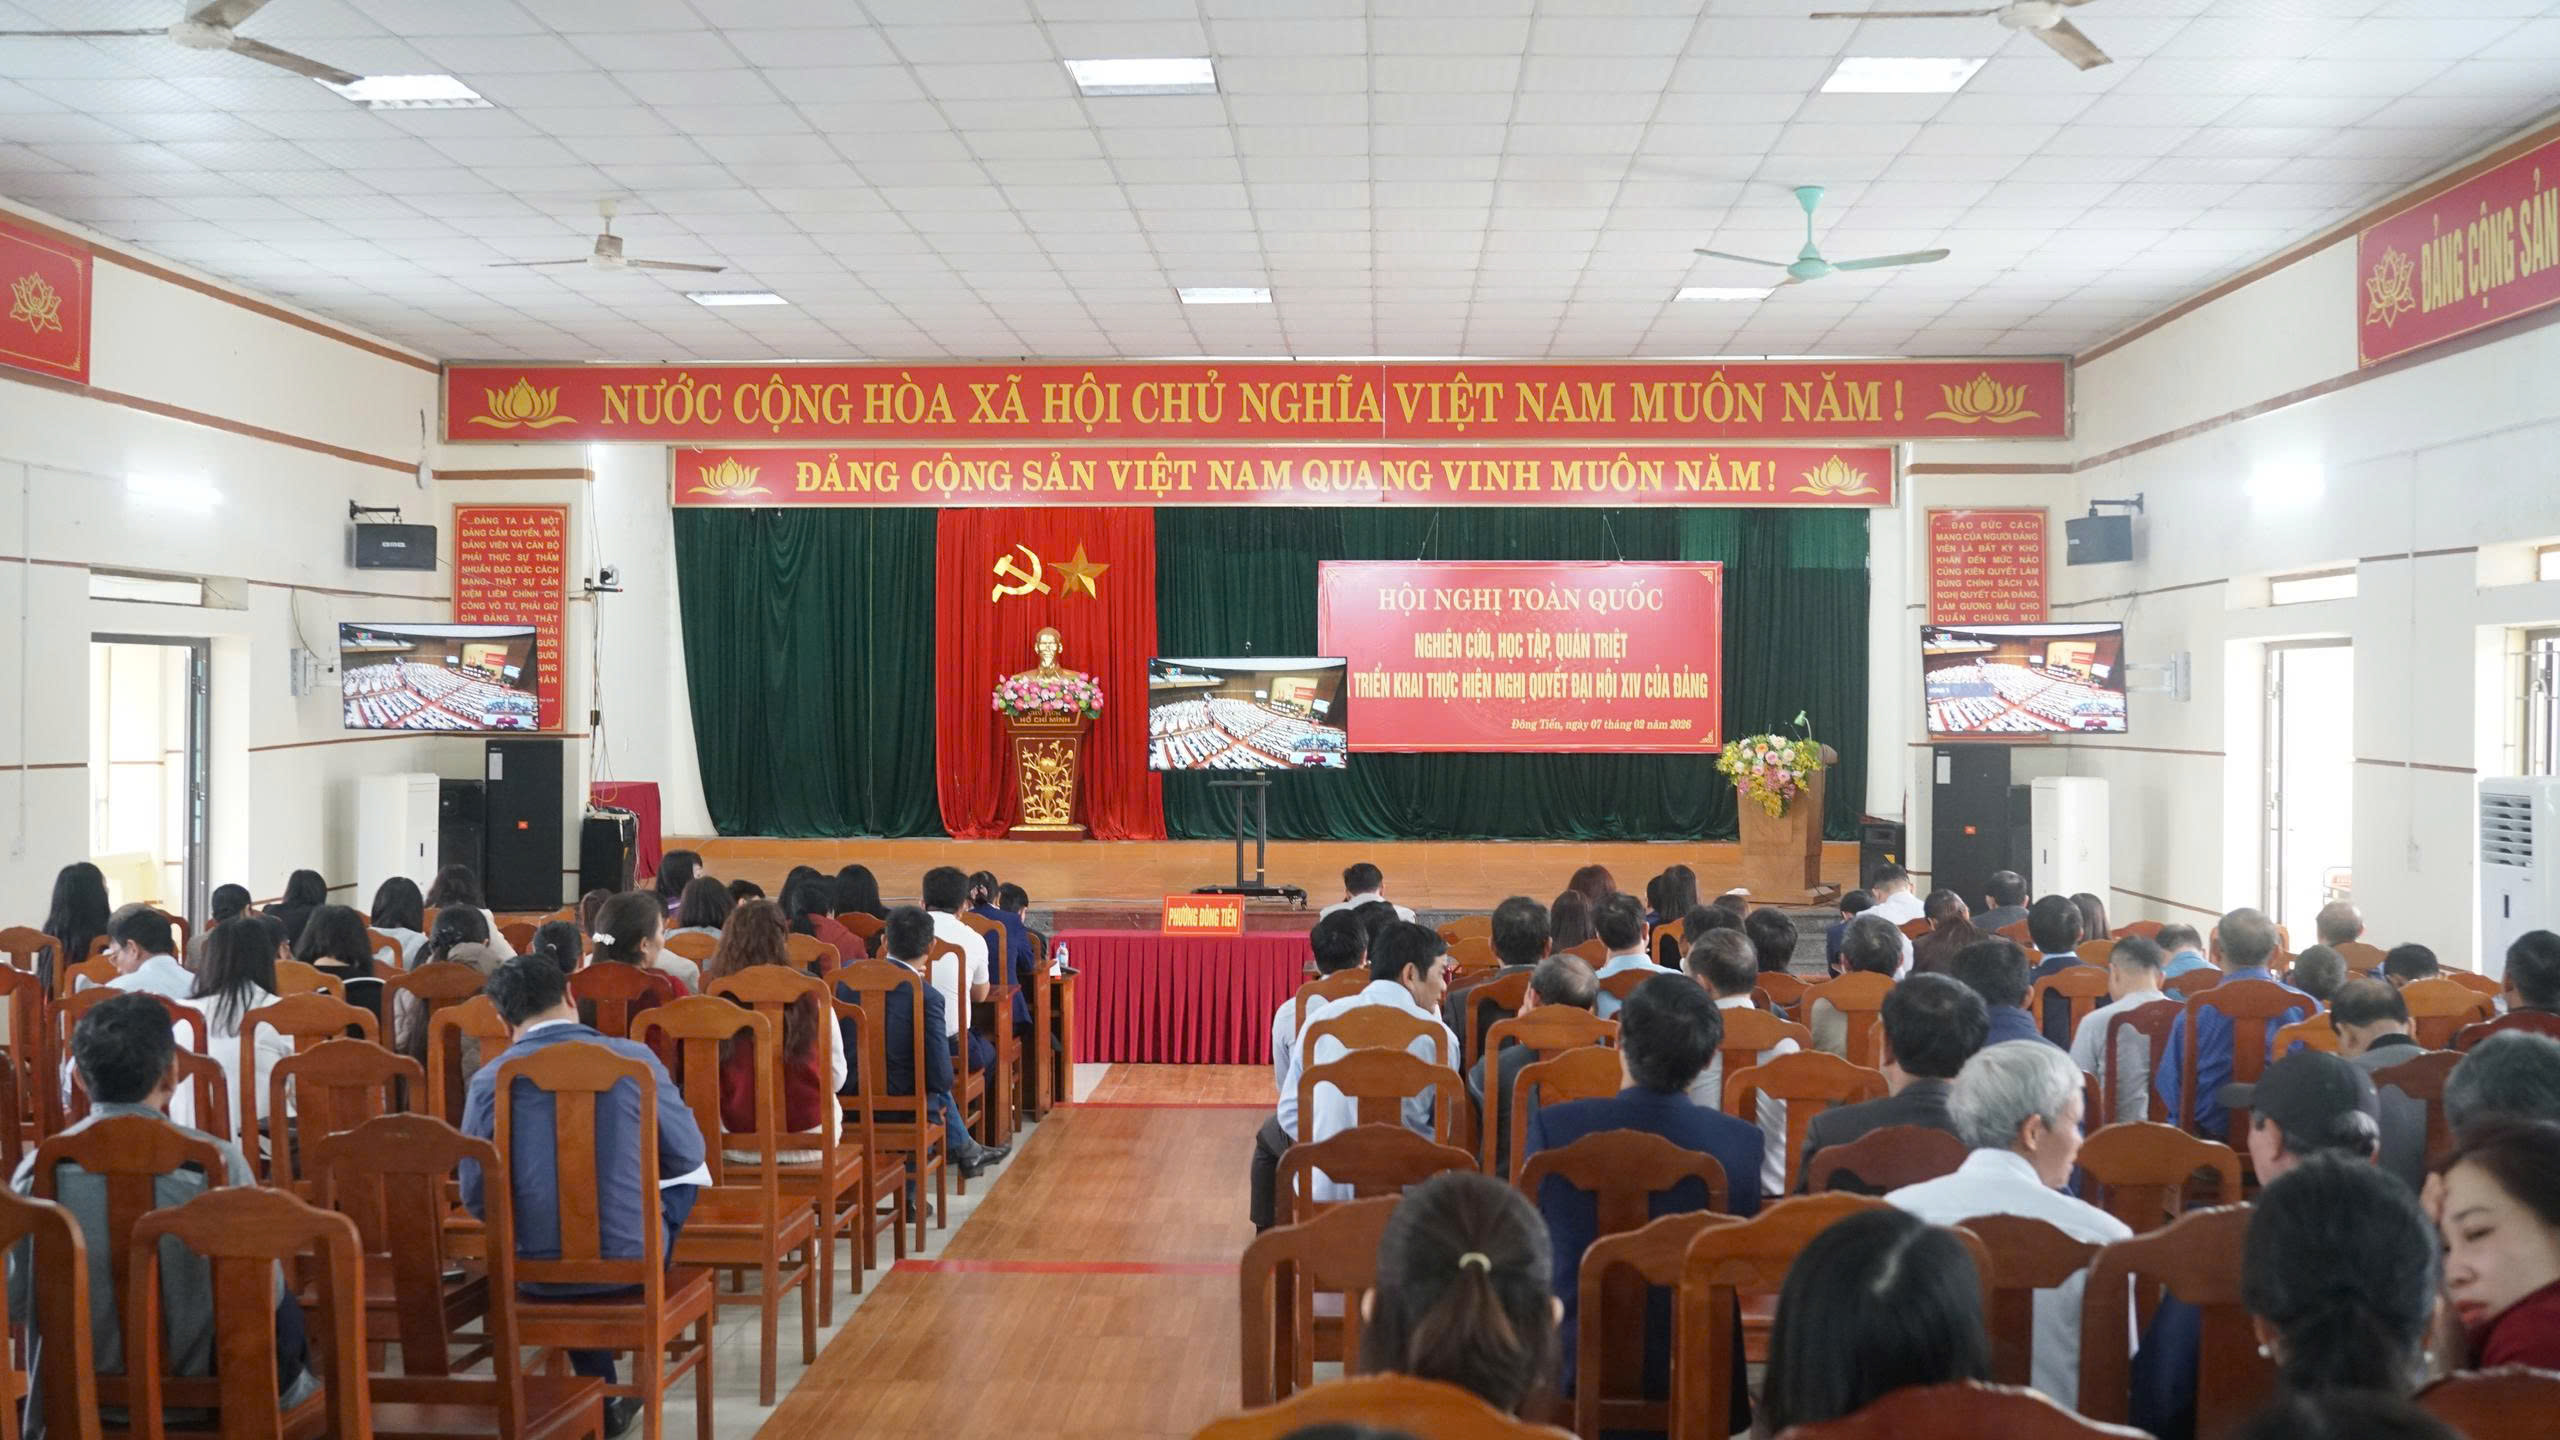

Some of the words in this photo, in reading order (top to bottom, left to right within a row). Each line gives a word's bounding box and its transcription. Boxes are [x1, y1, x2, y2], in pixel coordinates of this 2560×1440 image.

[2421, 213, 2465, 314] ĐẢNG
[2467, 201, 2516, 309] CỘNG
[2520, 167, 2560, 278] SẢN
[601, 373, 722, 425] NƯỚC
[733, 373, 853, 433] CỘNG
[863, 373, 956, 424] HÒA
[968, 374, 1030, 424] XÃ
[1041, 372, 1122, 433] HỘI
[1132, 370, 1226, 424] CHỦ
[1238, 375, 1384, 423] NGHĨA
[1395, 372, 1503, 432] VIỆT
[1515, 382, 1616, 423] NAM
[1630, 370, 1766, 423] MUÔN
[1781, 371, 1882, 422] NĂM
[795, 452, 900, 492] ĐẢNG
[910, 451, 1014, 499] CỘNG
[1021, 451, 1097, 492] SẢN
[1106, 451, 1197, 498] VIỆT
[1206, 460, 1294, 492] NAM
[1301, 458, 1434, 493] QUANG
[1441, 459, 1541, 491] VINH
[1550, 452, 1666, 492] MUÔN
[1378, 581, 1425, 617] HỘI
[1433, 588, 1503, 616] NGHỊ
[1509, 582, 1582, 611] TOÀN
[1588, 578, 1663, 615] QUỐC
[537, 639, 558, 648] GƯỜI
[537, 649, 558, 659] GƯỜI
[1414, 628, 1463, 660] NGHIÊN
[1498, 632, 1524, 664] HỌC
[1527, 628, 1553, 665] TẬP,
[1555, 627, 1591, 660] QUÁN
[1593, 627, 1629, 665] TRIỆT
[1353, 662, 1391, 699] TRIỂN
[1394, 672, 1424, 699] KHAI
[1427, 671, 1459, 704] THỰC
[1462, 667, 1493, 704] HIỆN
[1495, 672, 1526, 704] NGHỊ
[1529, 664, 1569, 700] QUYẾT
[1571, 672, 1593, 704] ĐẠI
[1596, 667, 1618, 704] HỘI
[1620, 672, 1641, 698] XIV
[1644, 665, 1671, 699] CỦA
[1673, 665, 1709, 699] ĐẢNG
[1511, 718, 1537, 731] Đông
[1565, 718, 1588, 732] ngày
[1590, 719, 1602, 730] 07
[1604, 718, 1632, 732] tháng
[1647, 718, 1669, 730] năm
[1168, 902, 1198, 927] PHƯỜNG
[1199, 903, 1220, 927] ĐÔNG
[1221, 901, 1238, 928] TIẾN
